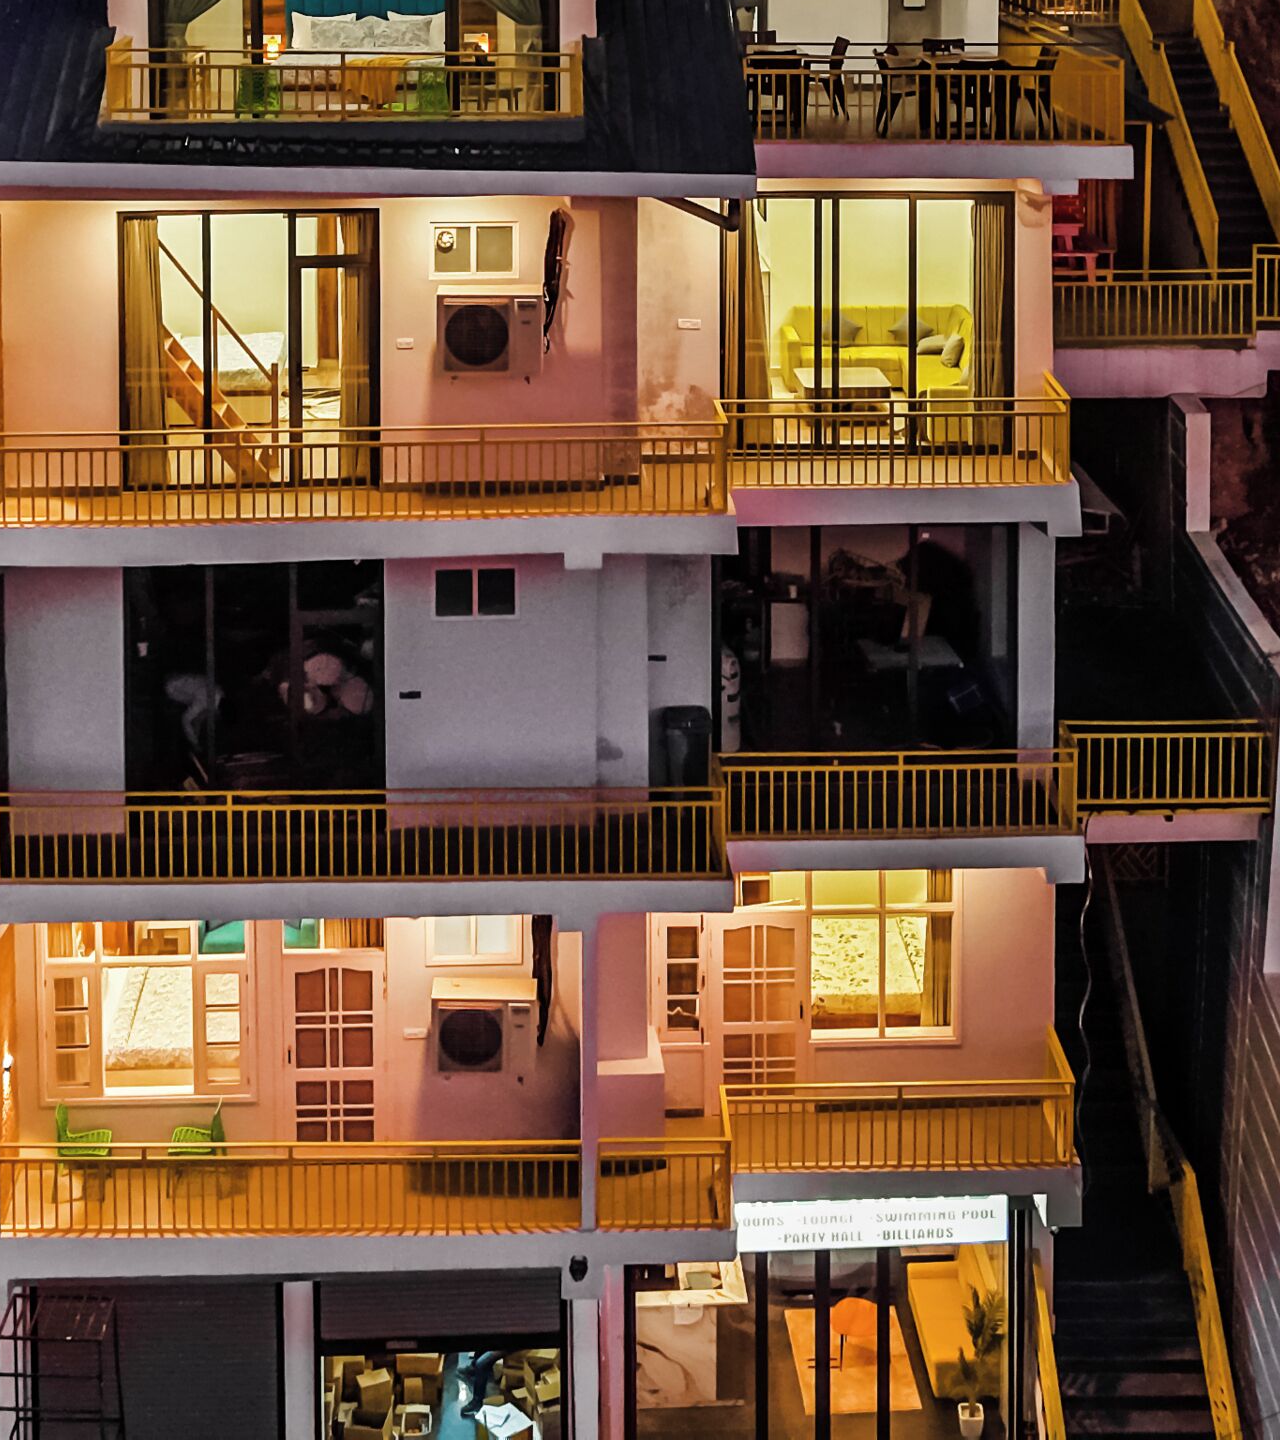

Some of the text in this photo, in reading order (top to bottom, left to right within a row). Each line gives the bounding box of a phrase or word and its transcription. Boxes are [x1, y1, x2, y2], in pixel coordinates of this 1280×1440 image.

[737, 1215, 785, 1228] OOMS
[961, 1209, 997, 1220] POOL
[783, 1227, 954, 1244] PARTY HALL BILLIARDS
